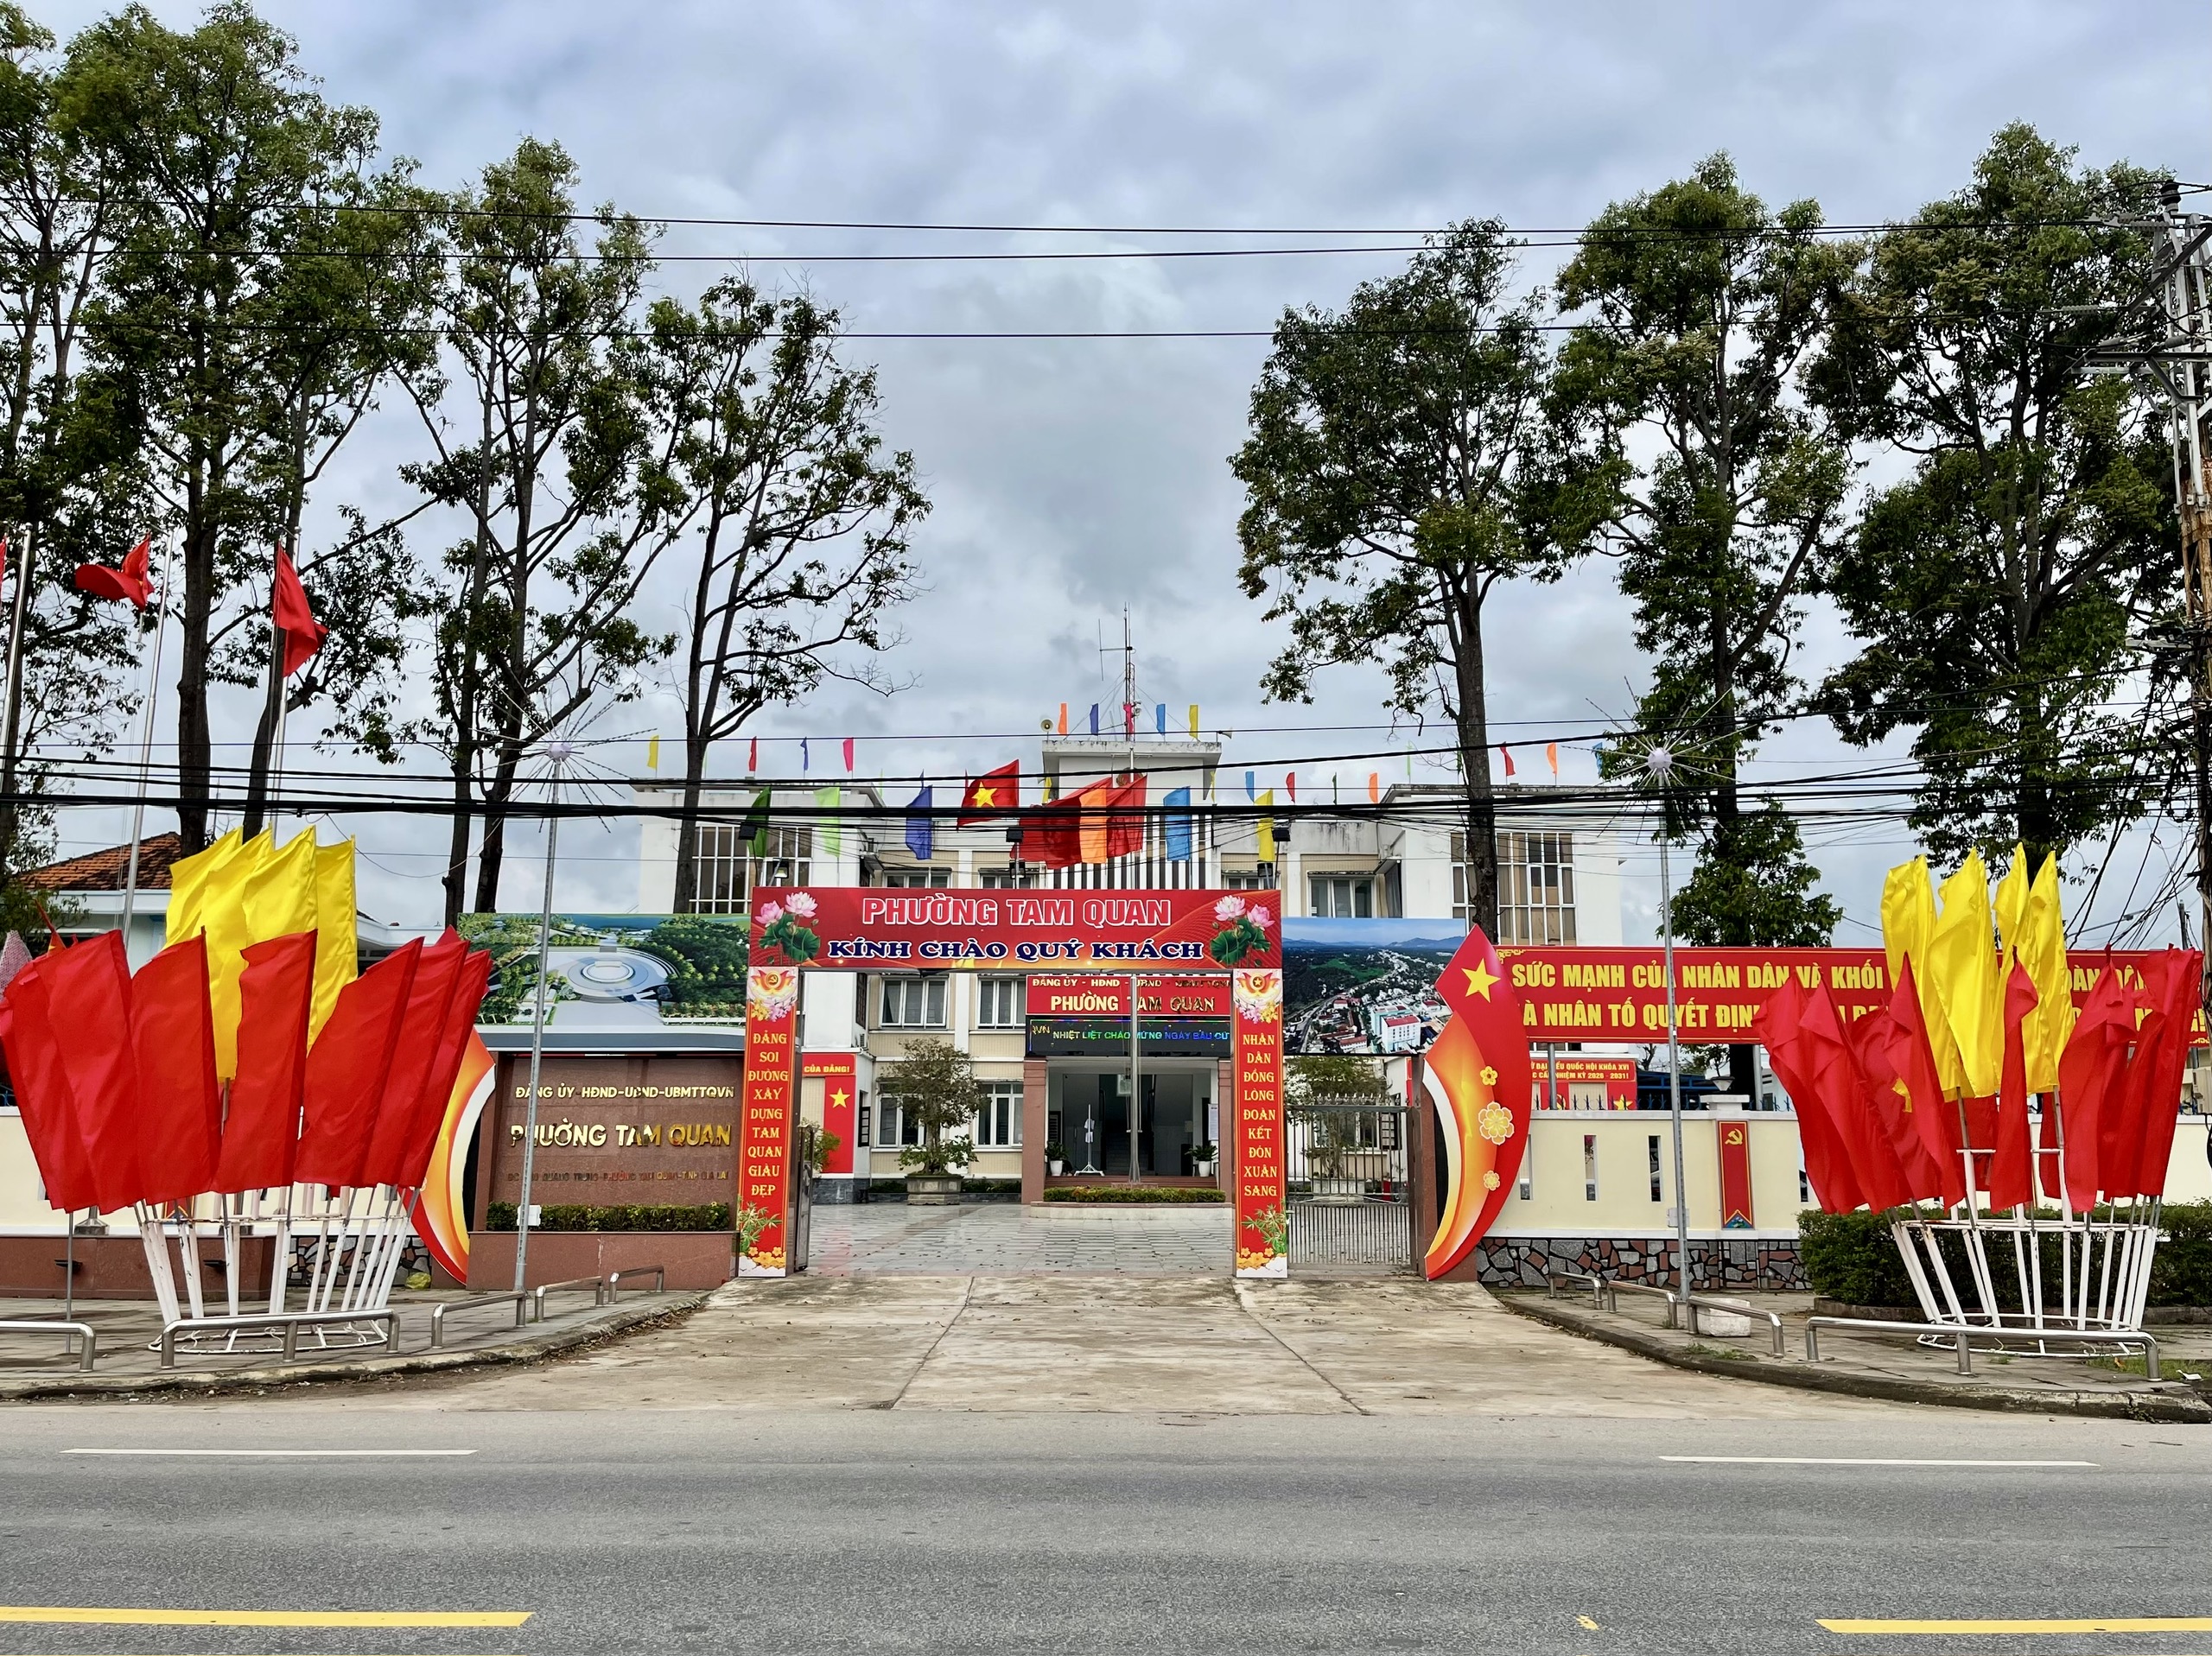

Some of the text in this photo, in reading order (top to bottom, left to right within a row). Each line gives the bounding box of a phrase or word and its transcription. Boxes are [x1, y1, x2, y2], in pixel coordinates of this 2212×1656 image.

[863, 893, 1171, 929] PHƯỜNG TAM QUAN
[828, 937, 1205, 961] KÍNH CHÀO QUÝ KHÁCH
[1512, 961, 1555, 987] SỨC
[1562, 964, 1625, 993] MẠNH
[1681, 961, 1740, 988] NHÂN
[1831, 959, 1884, 989] KHỐI
[1051, 990, 1119, 1011] PHƯỜNG
[1170, 996, 1214, 1012] QUAN
[1518, 999, 1538, 1026] À
[1543, 999, 1602, 1026] NHÂN
[1608, 996, 1637, 1027] TỐ
[1715, 1005, 1760, 1032] ĐỊN
[753, 1030, 787, 1044] ĐẢNG
[1243, 1032, 1274, 1045] NHÂN
[759, 1051, 779, 1063] SOI
[1247, 1051, 1271, 1063] DÂN
[1243, 1068, 1274, 1082] ĐỒNG
[753, 1087, 784, 1100] XÂY
[1244, 1088, 1274, 1101] LÒNG
[1243, 1107, 1275, 1120] ĐOÀN
[615, 1124, 662, 1146] TAM
[668, 1124, 731, 1146] QUAN
[752, 1127, 779, 1139] TAM
[1248, 1125, 1272, 1139] KẾT
[747, 1145, 782, 1158] QUAN
[1249, 1145, 1272, 1158] ĐÓN
[748, 1164, 779, 1177] GIÀU
[1243, 1164, 1277, 1177] XUÂN
[751, 1184, 776, 1198] ĐẸP
[1244, 1185, 1277, 1196] SANG
